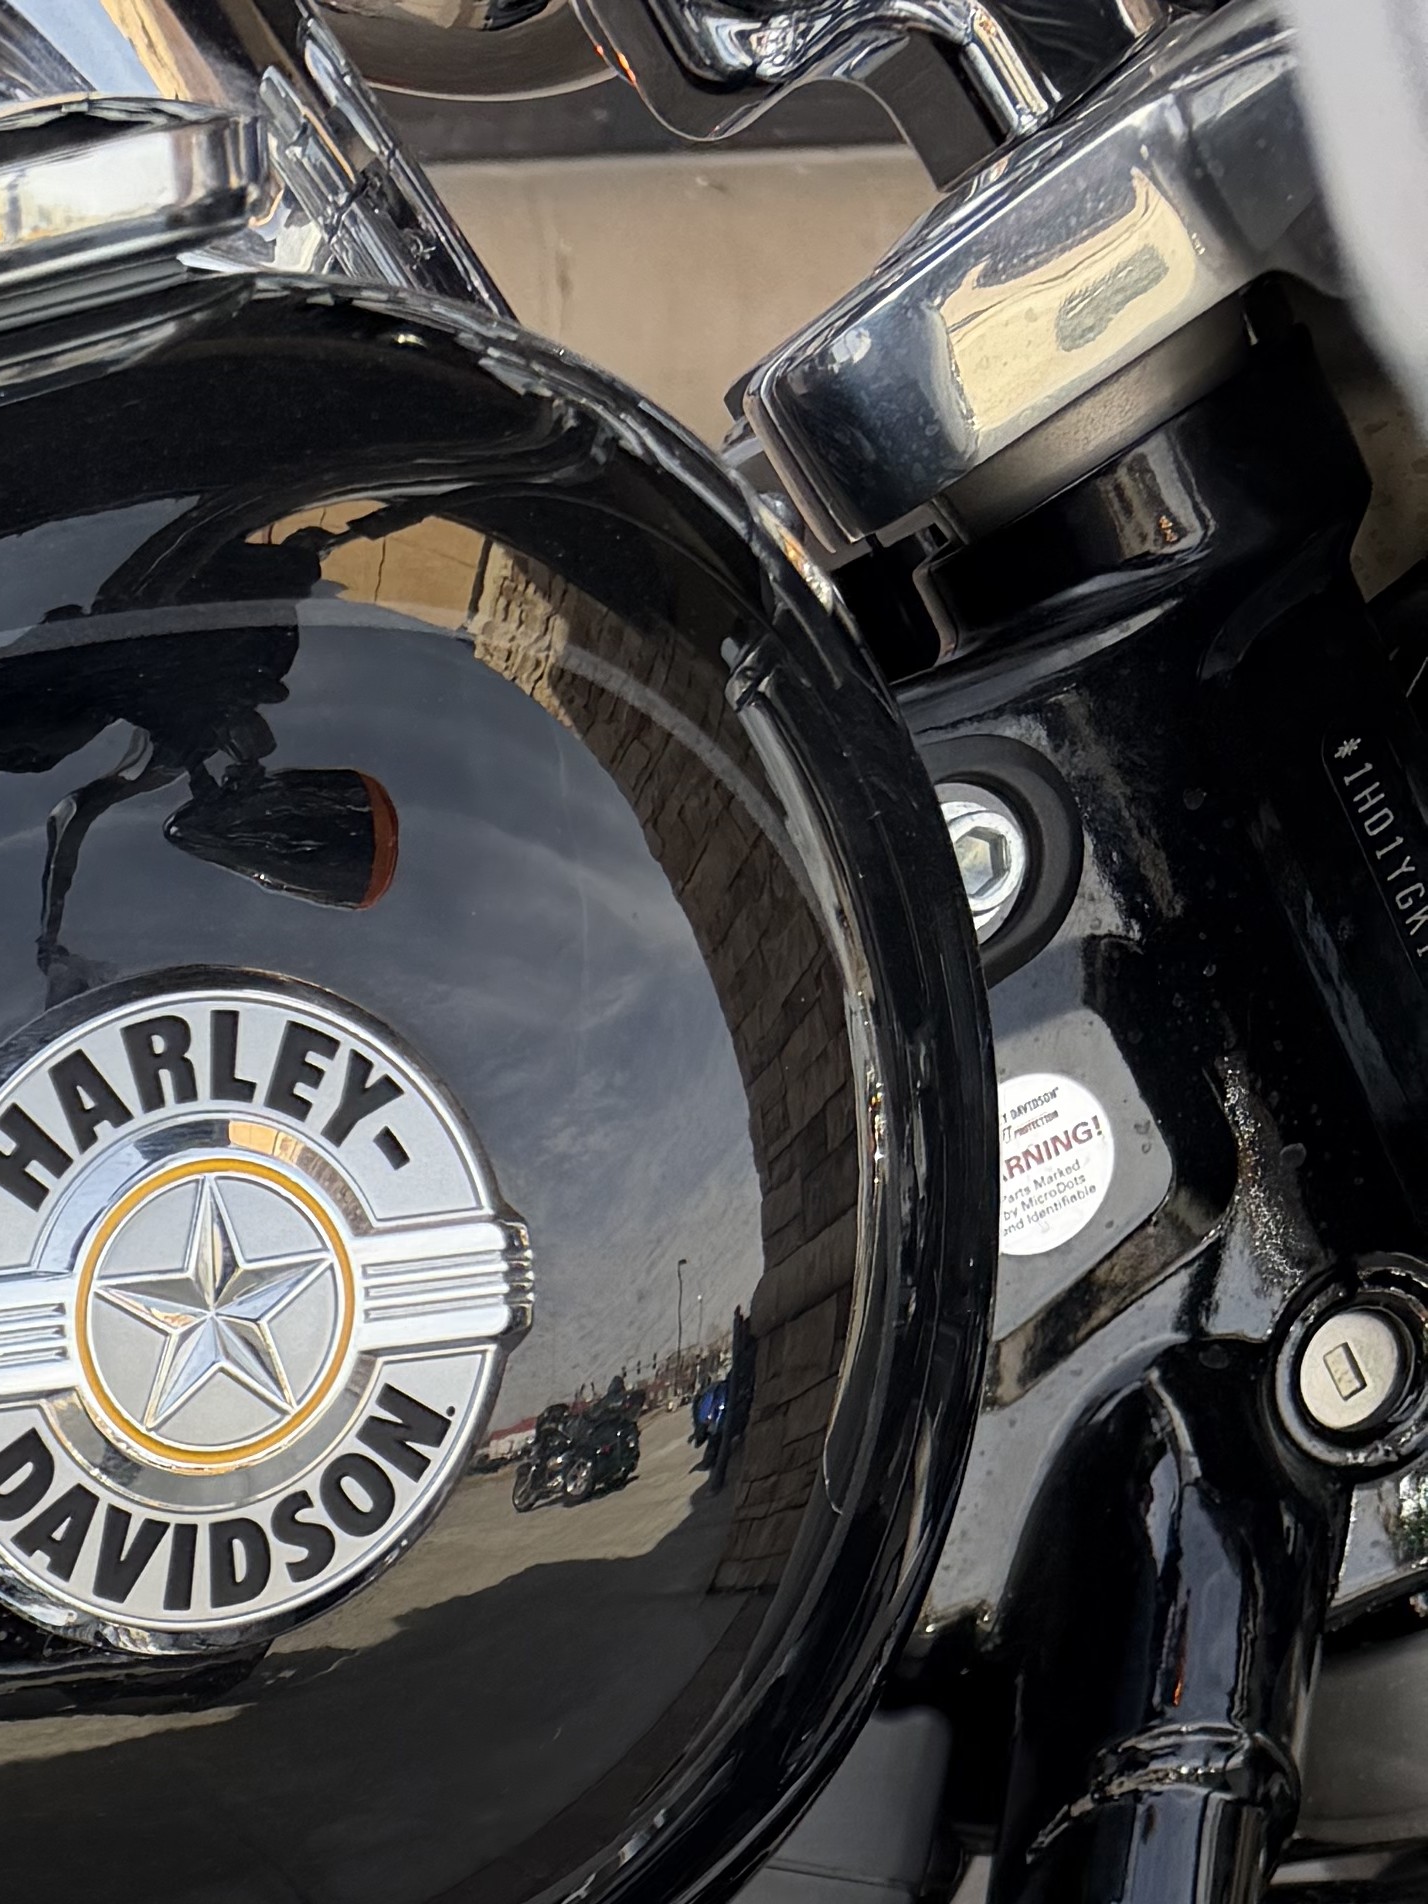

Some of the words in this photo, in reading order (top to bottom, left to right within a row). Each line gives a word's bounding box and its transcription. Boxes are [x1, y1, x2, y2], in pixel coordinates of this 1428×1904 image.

[1002, 1115, 1102, 1182] RNING!
[1021, 1174, 1085, 1212] MicroDots
[1033, 1159, 1081, 1191] Marked
[1027, 1184, 1097, 1225] Identifiable
